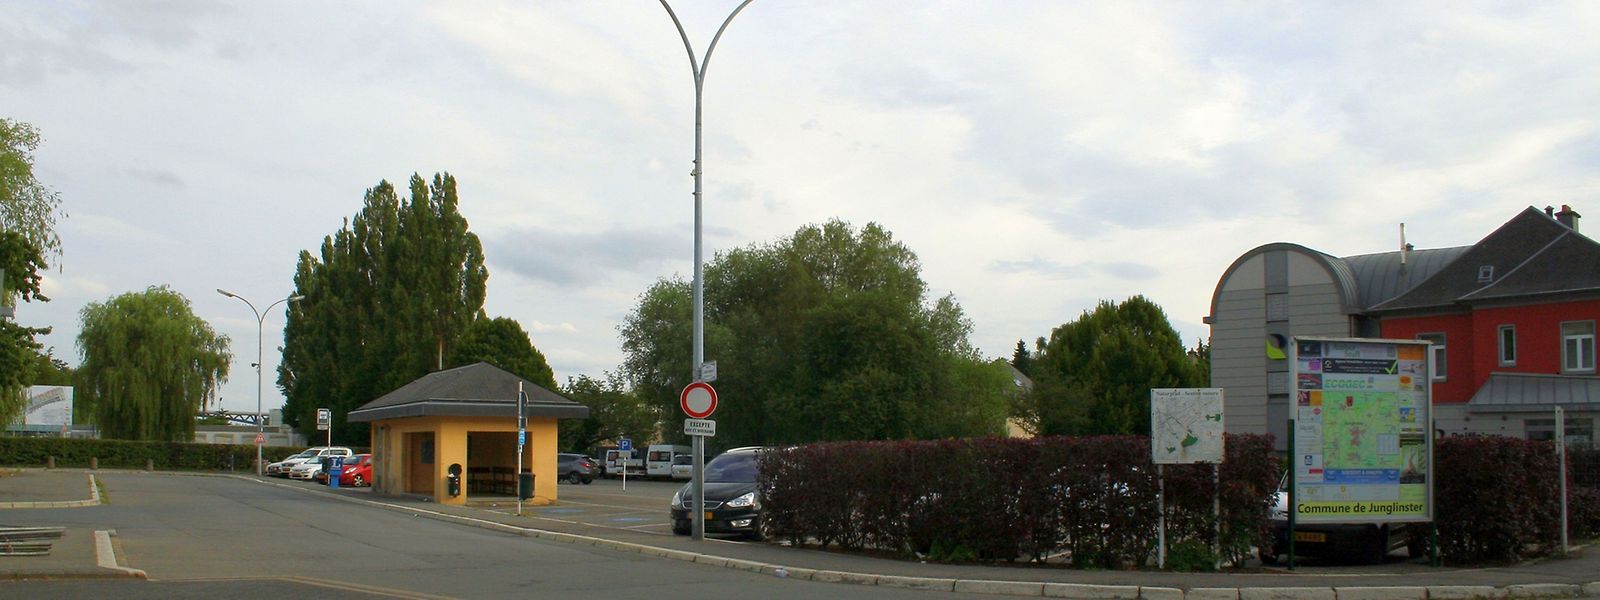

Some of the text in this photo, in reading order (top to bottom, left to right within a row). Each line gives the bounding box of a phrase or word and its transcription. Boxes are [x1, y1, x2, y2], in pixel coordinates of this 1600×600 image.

[622, 440, 629, 449] P
[1297, 502, 1424, 515] Commune de Junglinster
